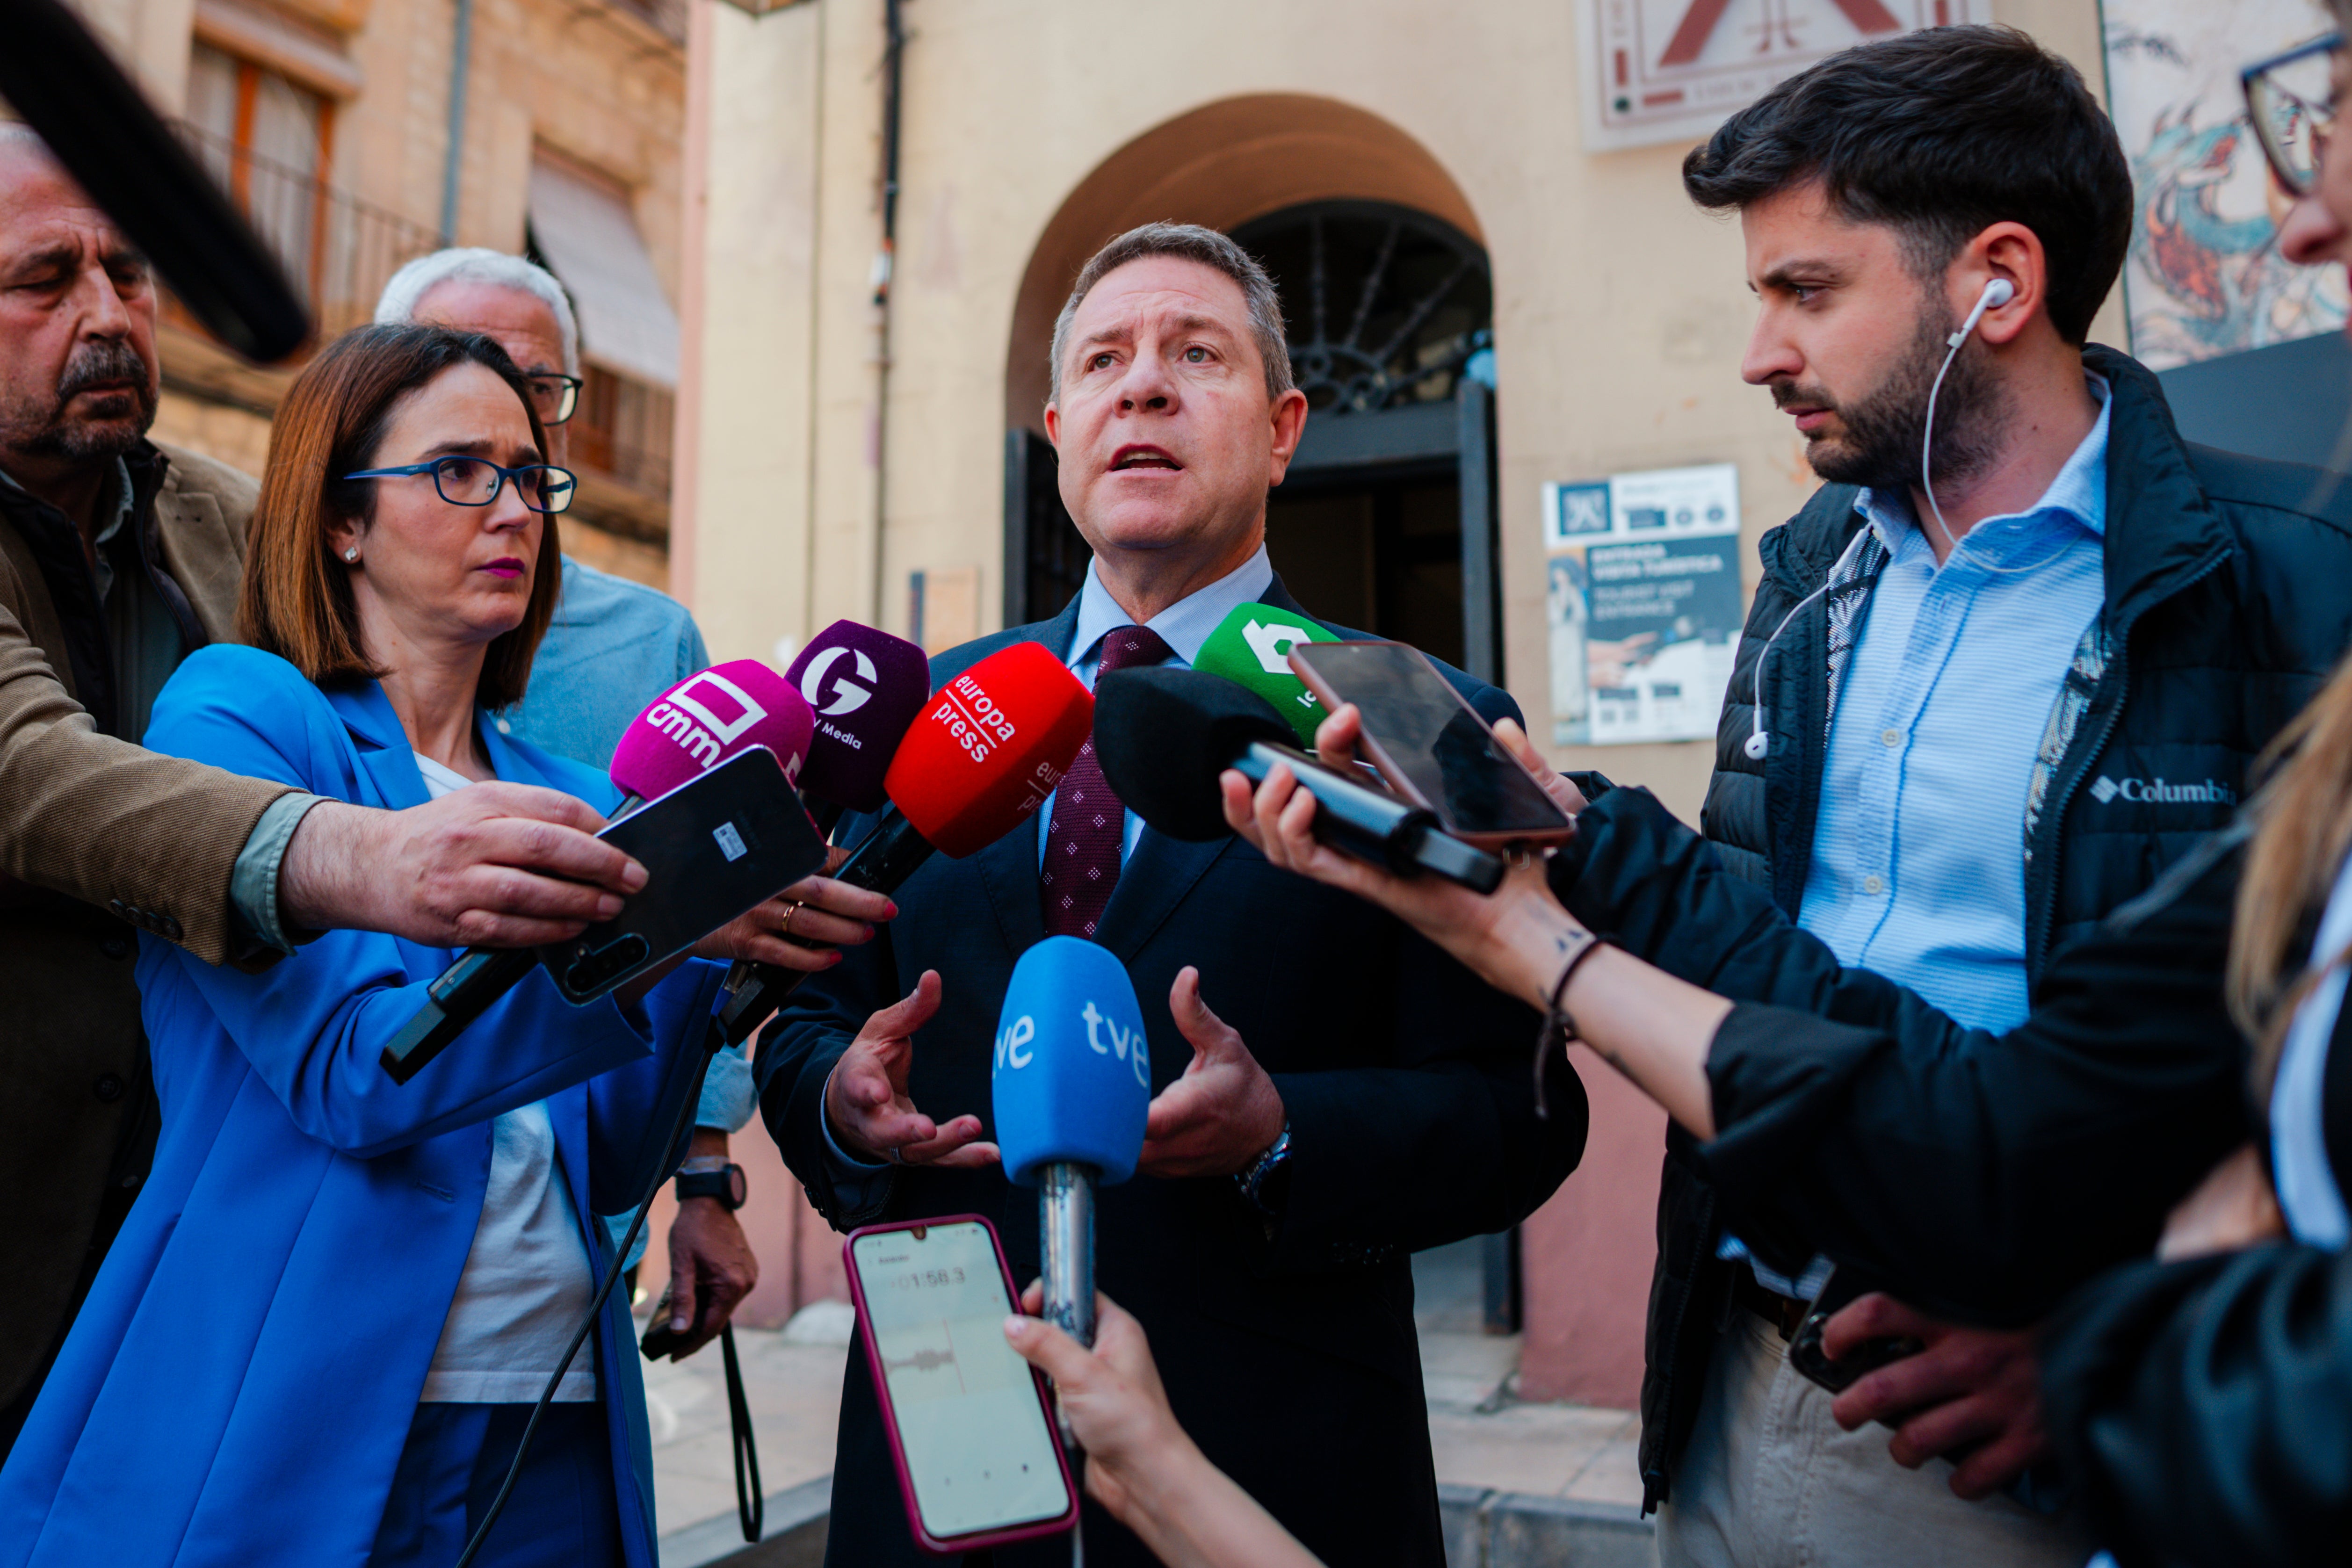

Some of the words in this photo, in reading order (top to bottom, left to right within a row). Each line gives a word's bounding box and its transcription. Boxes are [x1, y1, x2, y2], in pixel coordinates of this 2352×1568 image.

[646, 703, 721, 768] cmm
[822, 722, 861, 749] Media
[932, 702, 988, 763] press
[955, 676, 1015, 741] europa
[992, 1015, 1035, 1079] ve
[1082, 1001, 1148, 1089] tve
